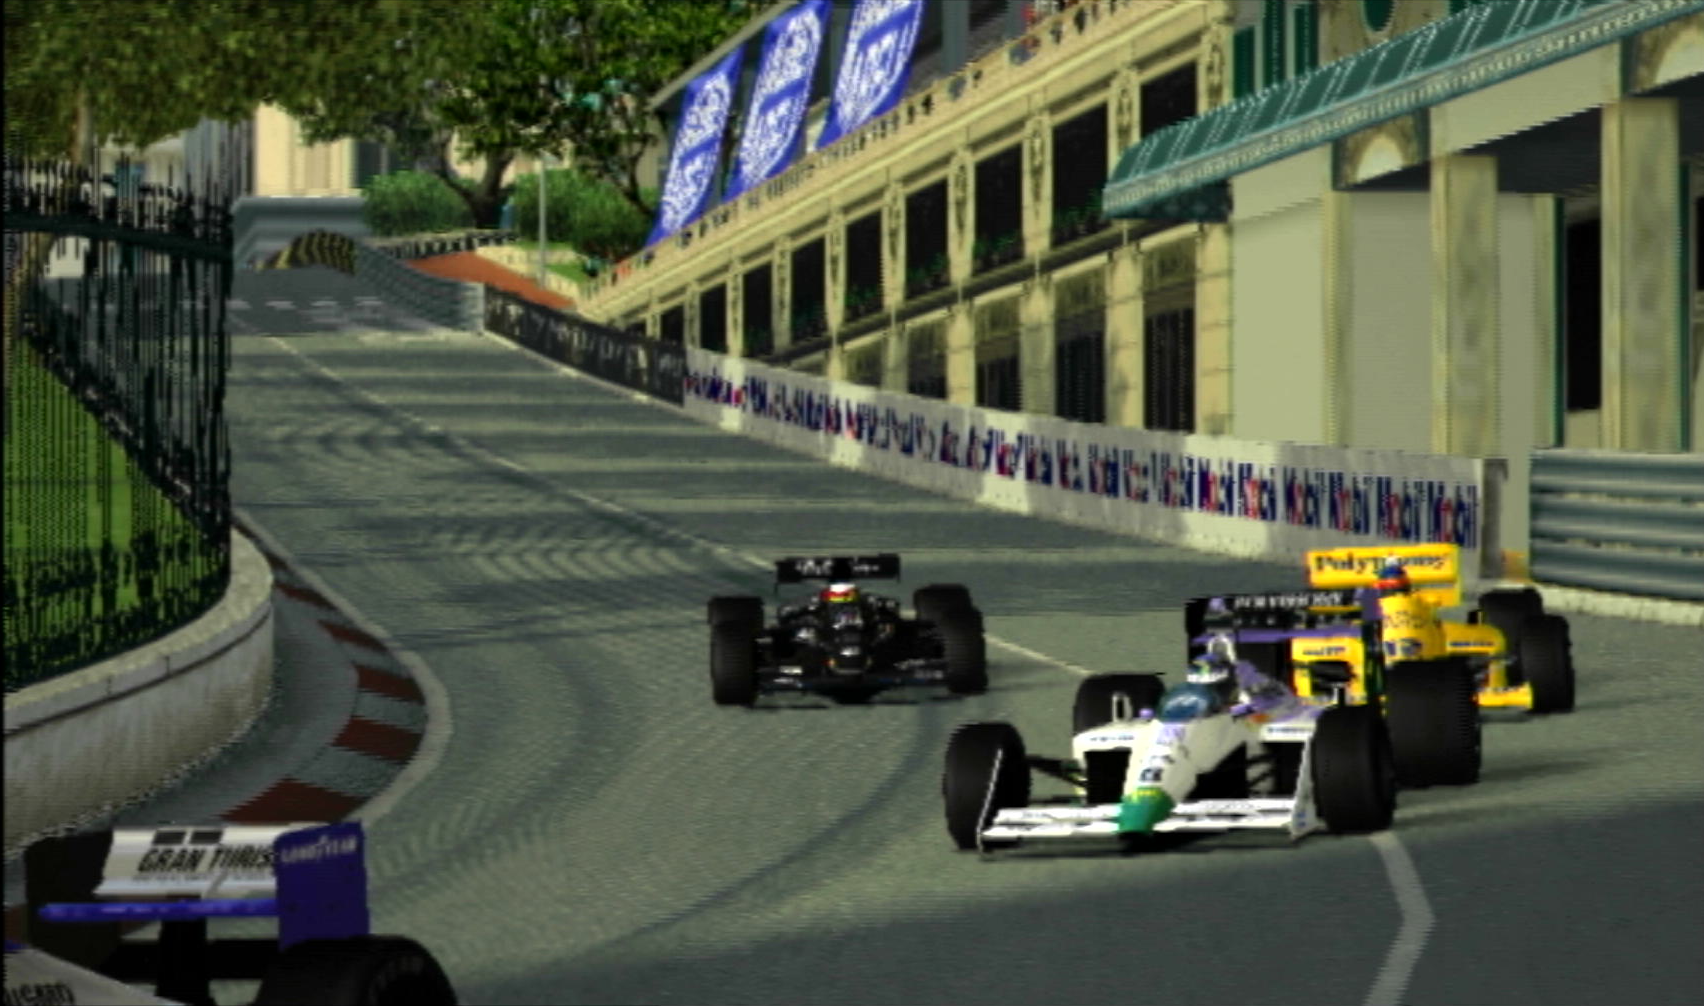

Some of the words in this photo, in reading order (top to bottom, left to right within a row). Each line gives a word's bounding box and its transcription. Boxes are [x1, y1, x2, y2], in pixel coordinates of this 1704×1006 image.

[1283, 467, 1325, 529] Mobil
[1328, 471, 1371, 537] Mobil
[1376, 475, 1424, 541] Mobil
[1427, 480, 1478, 549] Mobil
[138, 847, 206, 873] GRAN
